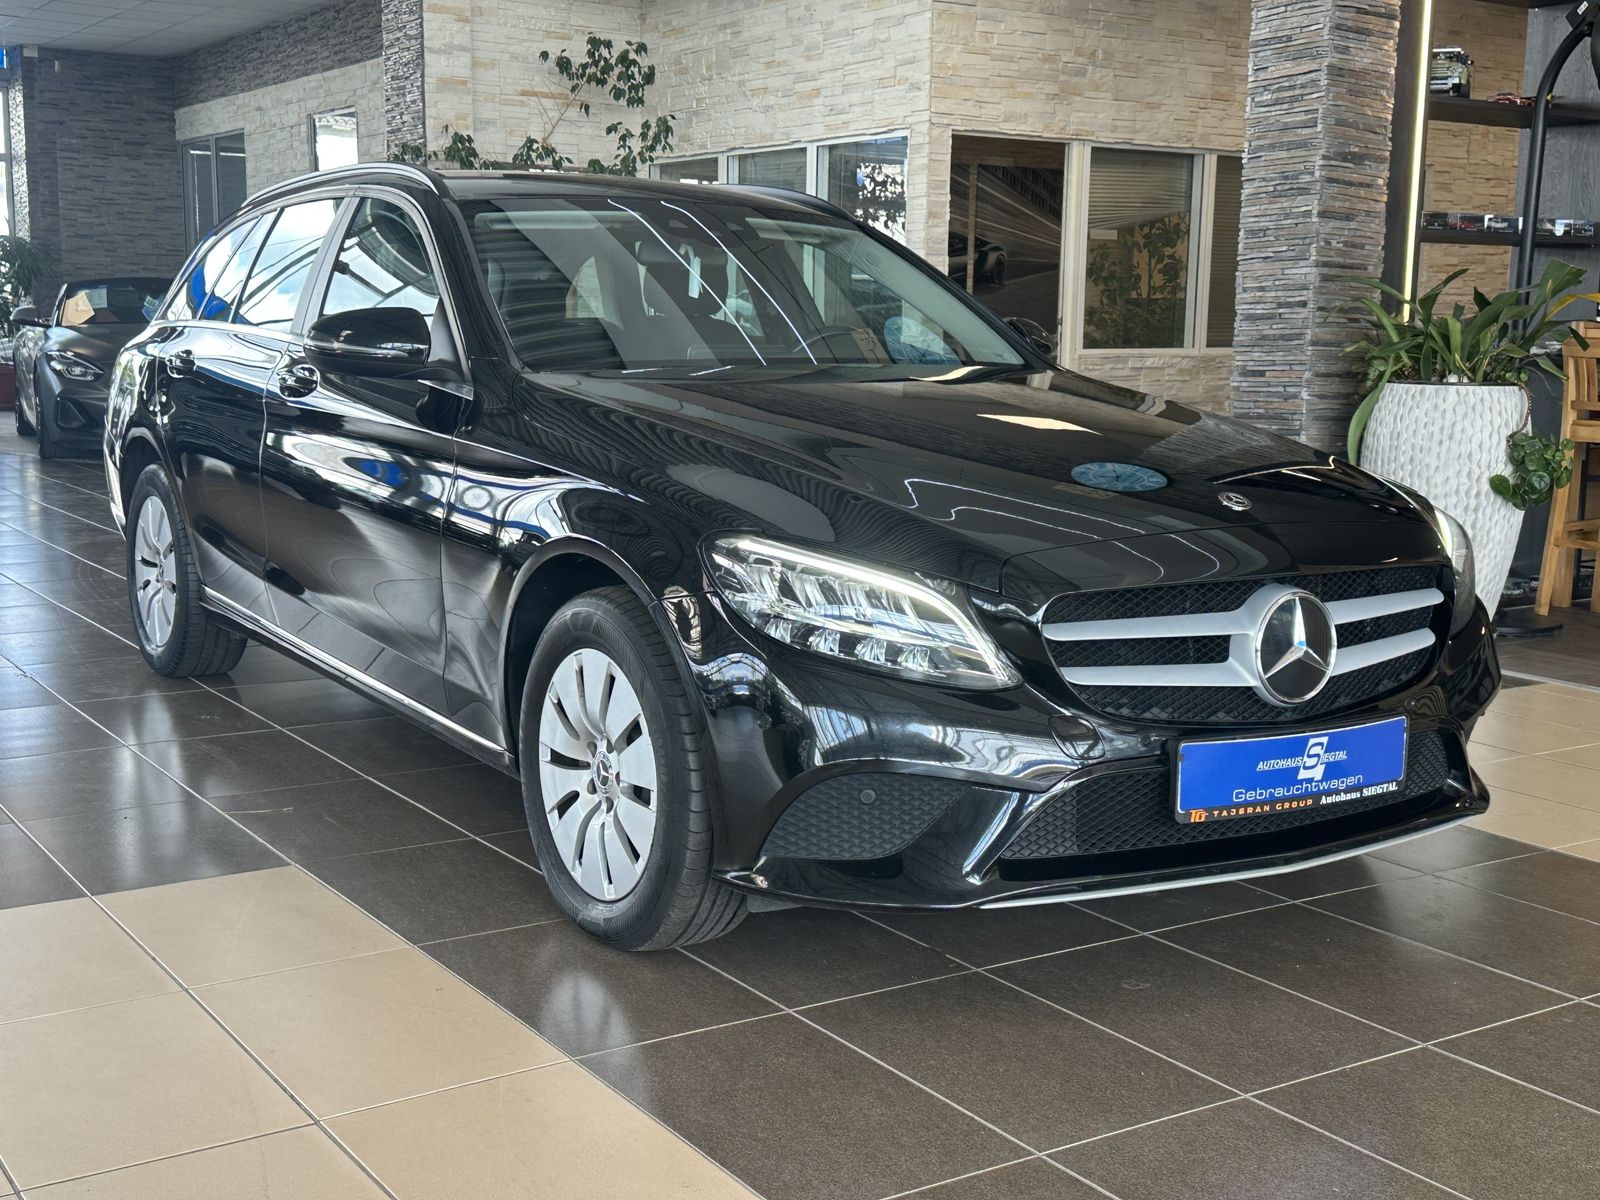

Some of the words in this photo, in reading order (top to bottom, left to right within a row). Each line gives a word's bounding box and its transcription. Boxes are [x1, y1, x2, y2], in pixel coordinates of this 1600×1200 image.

[1257, 757, 1304, 771] AUTOHAUS
[1232, 774, 1363, 803] Gebrauchtwagen
[1320, 791, 1361, 805] Autohaus
[1362, 781, 1398, 797] SIEGTAL
[1275, 799, 1313, 811] GROUP
